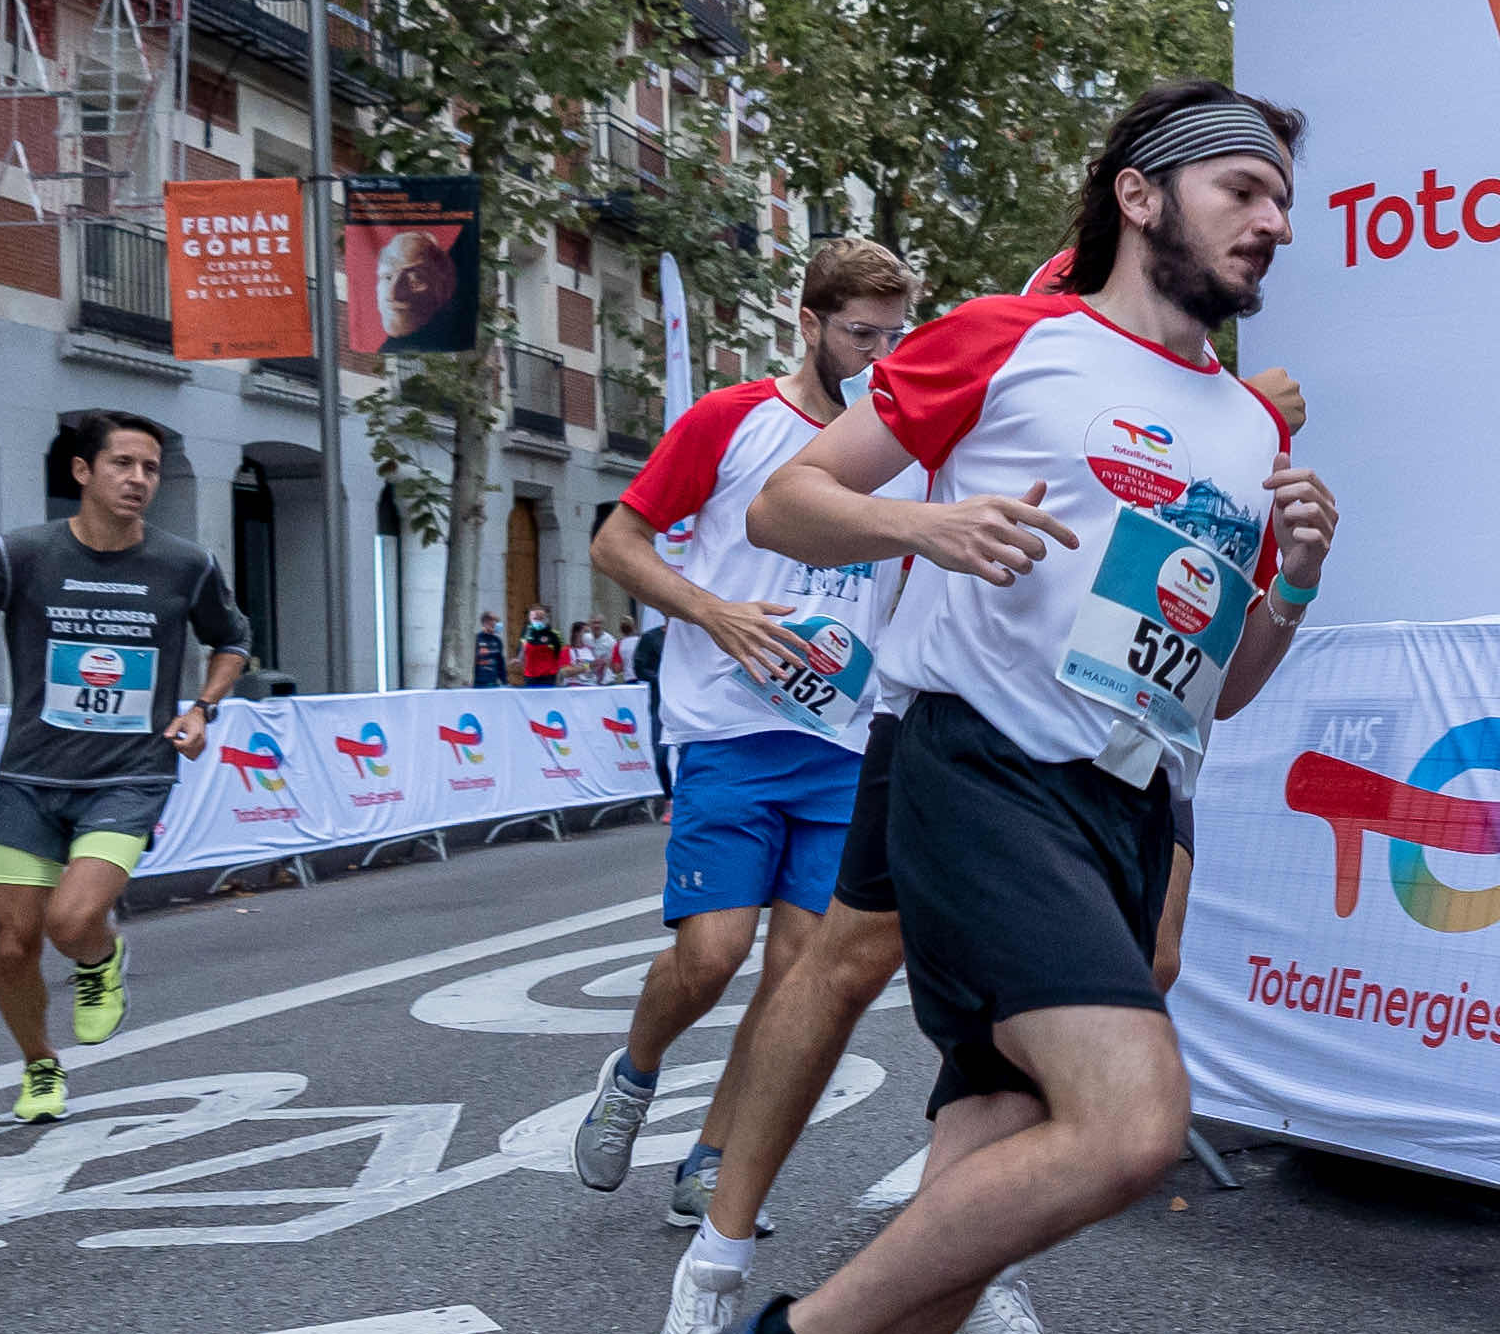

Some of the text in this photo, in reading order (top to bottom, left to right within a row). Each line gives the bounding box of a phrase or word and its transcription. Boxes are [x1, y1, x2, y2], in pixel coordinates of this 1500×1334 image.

[181, 210, 290, 235] FERNÁN
[183, 234, 291, 257] GÓMEZ
[206, 259, 274, 272] CENTRO
[197, 273, 282, 286] CULTURAL
[185, 285, 293, 300] DE LA VILLA
[51, 620, 73, 634] DE
[74, 622, 94, 635] LA
[1128, 616, 1203, 703] 522
[1081, 667, 1129, 695] MADRID
[75, 687, 125, 715] 487
[1318, 715, 1383, 761] AMS
